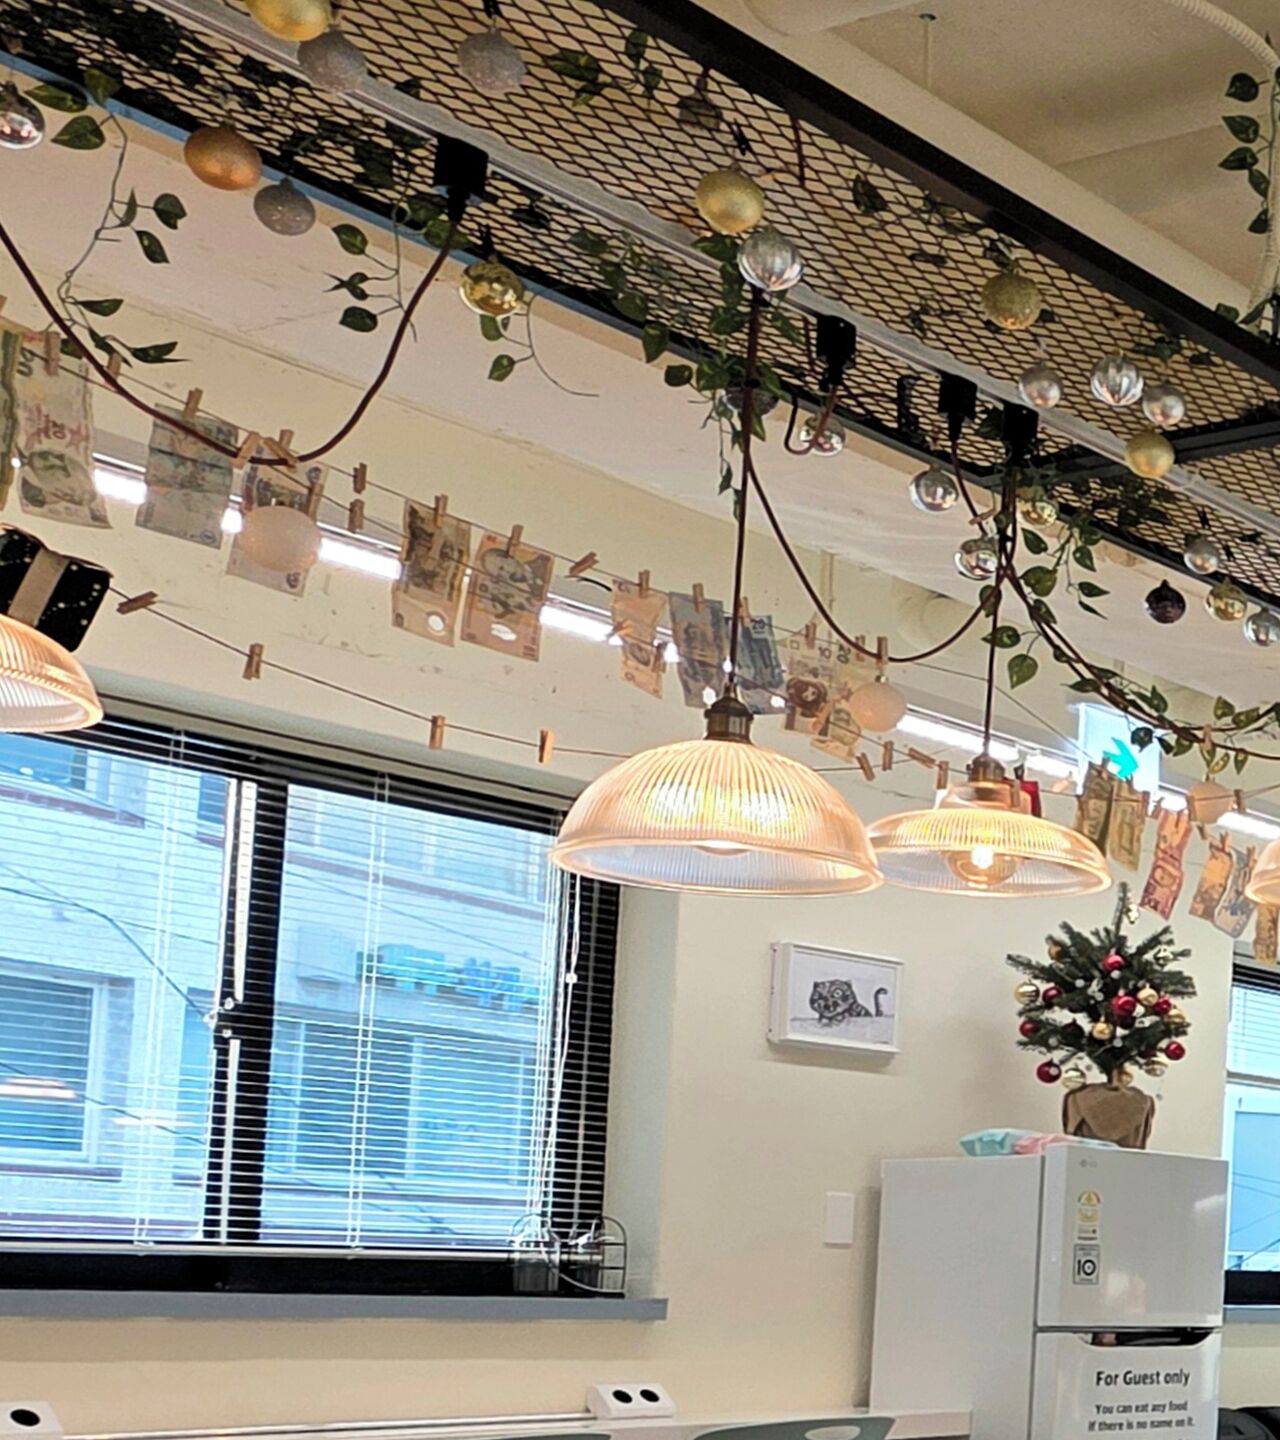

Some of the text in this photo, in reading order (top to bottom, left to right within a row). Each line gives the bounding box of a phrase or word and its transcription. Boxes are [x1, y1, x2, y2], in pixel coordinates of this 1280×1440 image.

[1096, 1368, 1190, 1387] For Guest only
[1095, 1404, 1114, 1415] You
[1116, 1405, 1133, 1413] can
[1169, 1400, 1187, 1411] food
[1098, 1421, 1124, 1431] there
